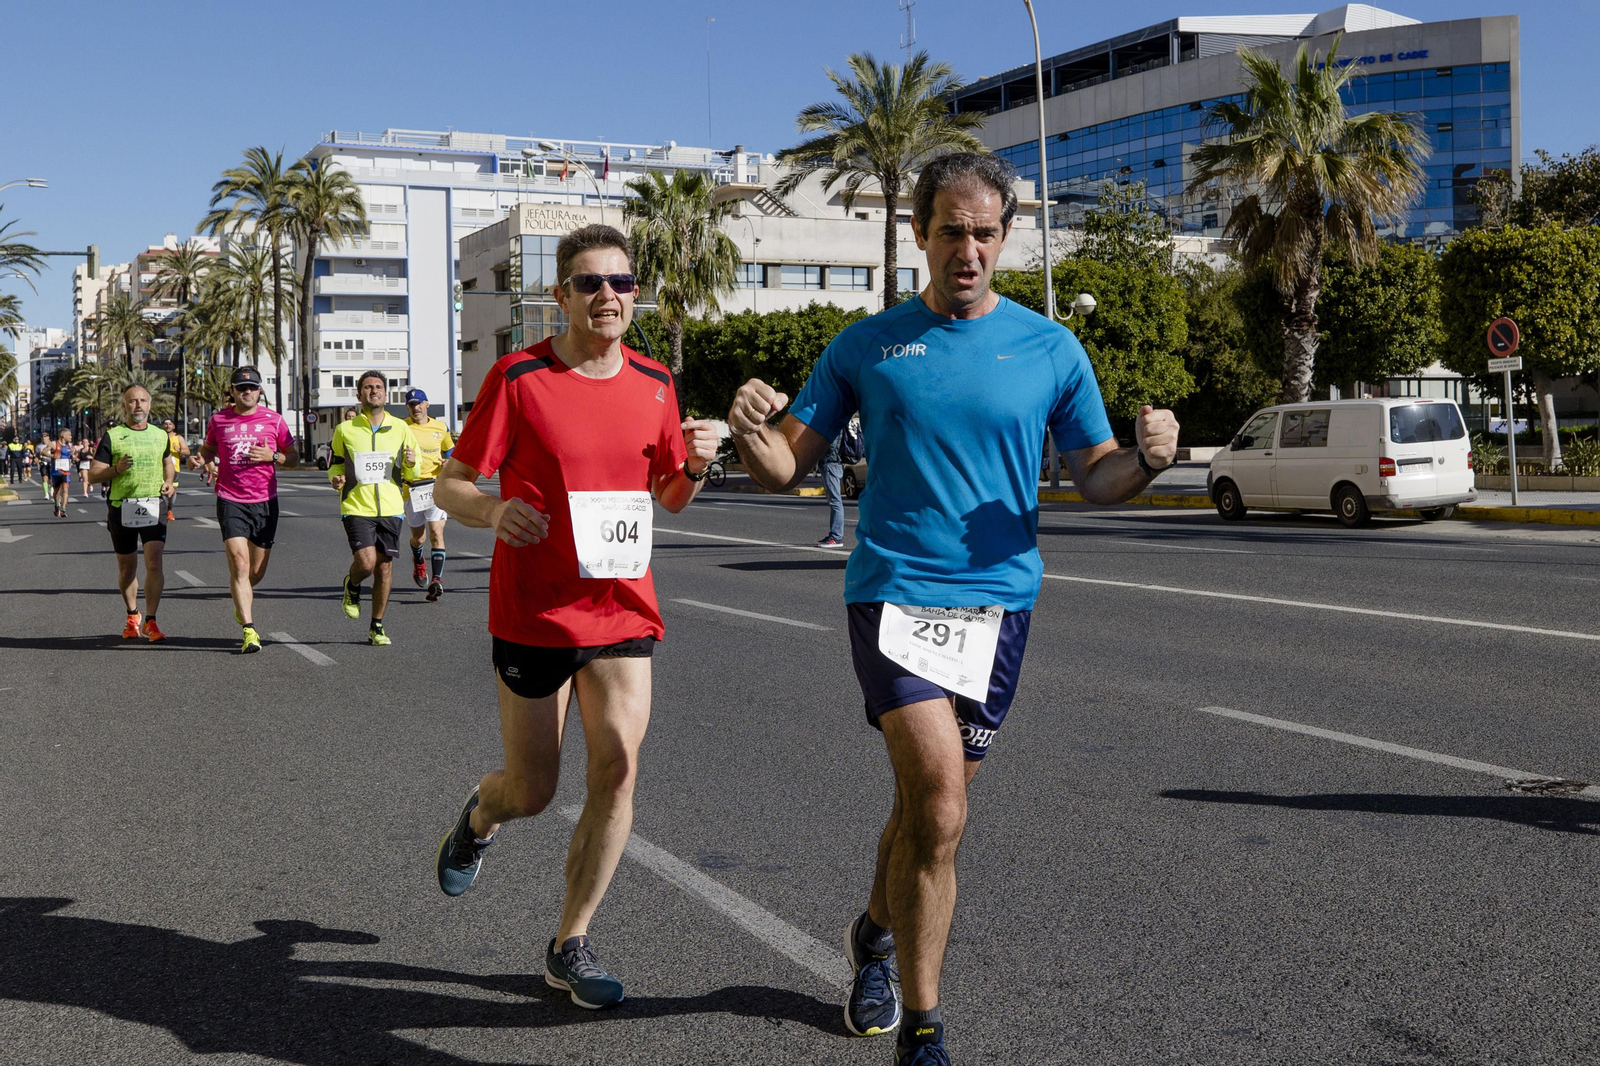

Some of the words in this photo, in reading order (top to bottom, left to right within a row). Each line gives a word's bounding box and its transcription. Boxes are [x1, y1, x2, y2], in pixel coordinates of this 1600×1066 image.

[1379, 53, 1394, 64] DE
[525, 208, 571, 220] JEFATURA
[881, 343, 927, 360] YOHR
[365, 461, 384, 472] 559
[134, 507, 148, 516] 42
[599, 519, 639, 544] 604
[946, 611, 959, 619] DE
[911, 620, 967, 654] 291
